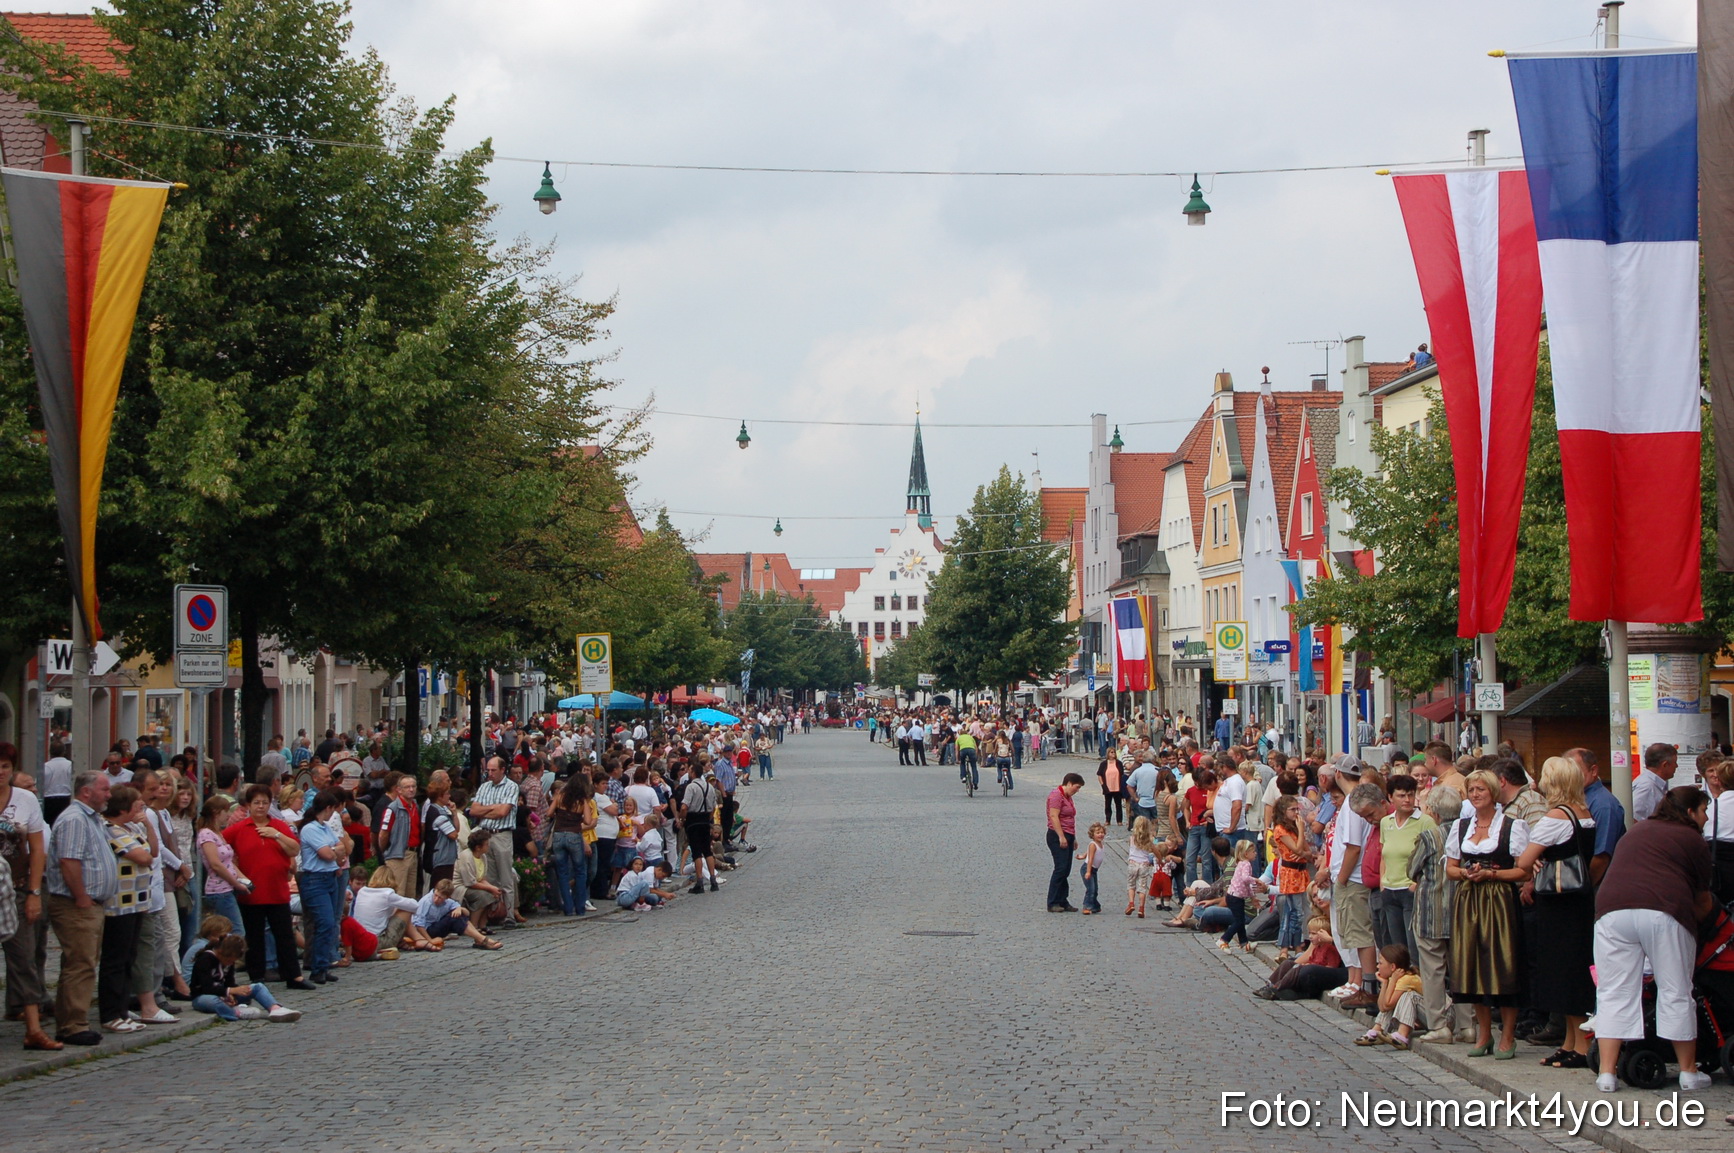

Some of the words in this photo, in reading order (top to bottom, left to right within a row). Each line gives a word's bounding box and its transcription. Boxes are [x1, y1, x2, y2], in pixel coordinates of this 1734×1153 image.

[190, 633, 213, 643] ZONE
[183, 658, 200, 667] Parken
[211, 659, 220, 667] mit
[181, 668, 222, 677] Bewohnerausweis
